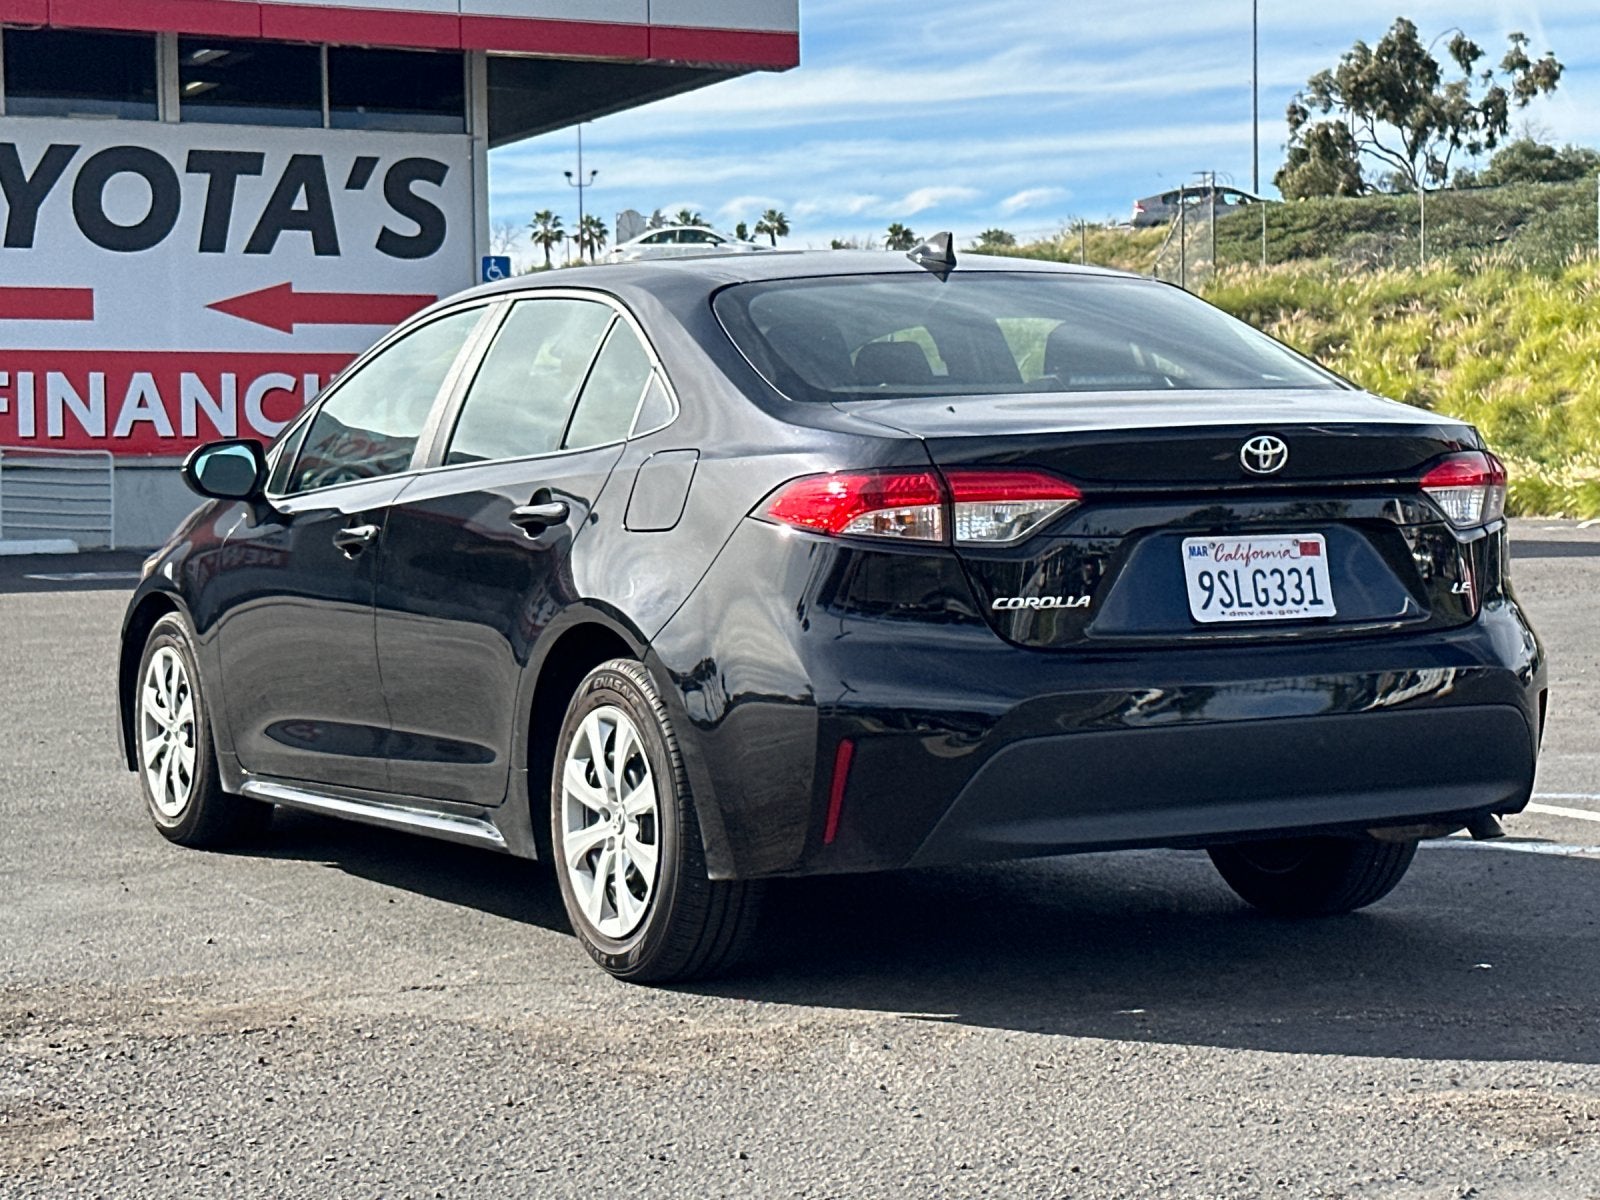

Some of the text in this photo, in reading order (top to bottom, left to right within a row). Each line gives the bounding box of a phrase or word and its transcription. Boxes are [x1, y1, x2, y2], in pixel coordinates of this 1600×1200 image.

[0, 142, 449, 260] YOTA'S
[0, 371, 336, 437] INANC
[1188, 546, 1208, 557] MAR
[1214, 543, 1300, 567] California
[992, 595, 1091, 610] COROLLA
[1198, 566, 1324, 610] 9SLG331
